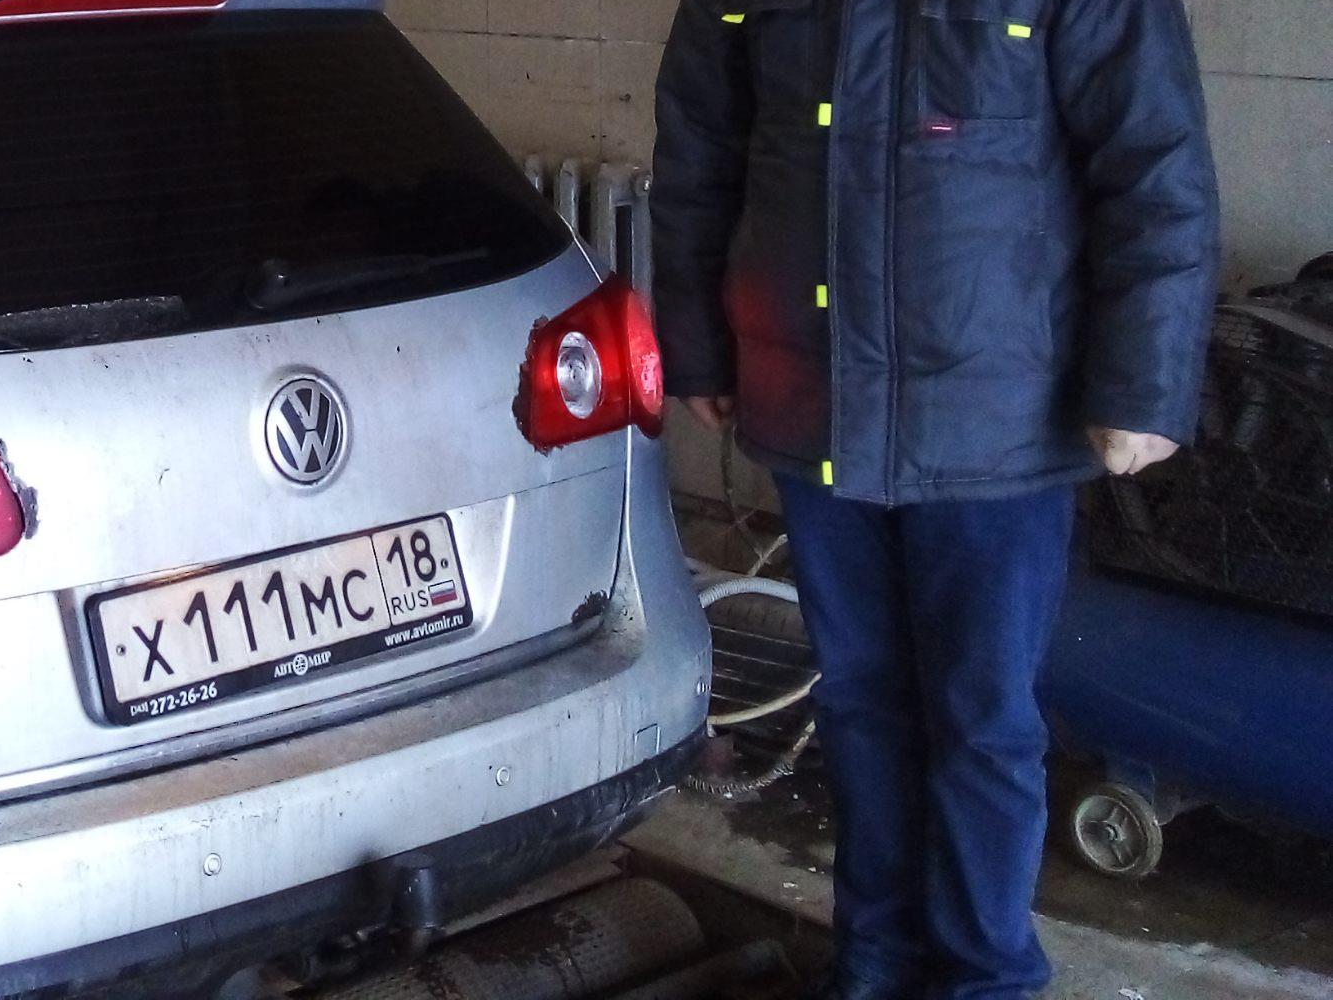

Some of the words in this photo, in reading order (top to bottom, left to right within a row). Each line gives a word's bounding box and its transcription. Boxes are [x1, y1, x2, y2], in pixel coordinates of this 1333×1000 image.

[386, 530, 437, 587] 18
[391, 590, 429, 616] RUS
[384, 615, 464, 647] www.avtomir.ru
[150, 681, 218, 715] 272-26-26
